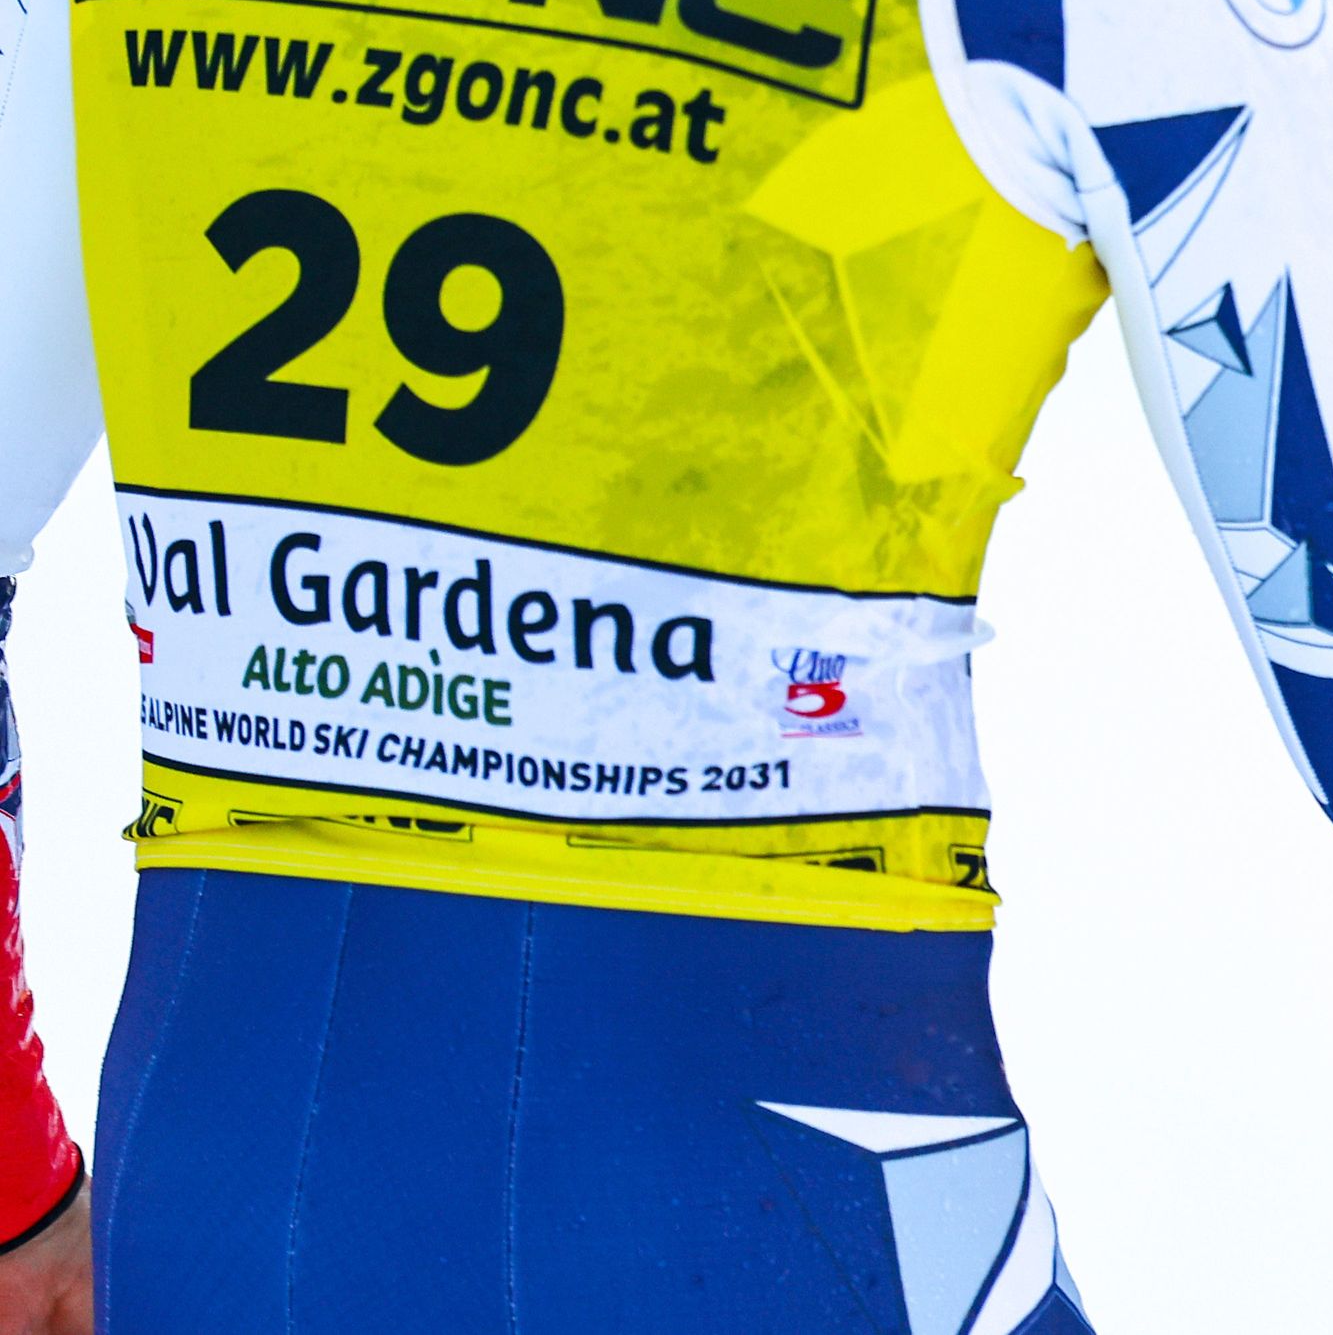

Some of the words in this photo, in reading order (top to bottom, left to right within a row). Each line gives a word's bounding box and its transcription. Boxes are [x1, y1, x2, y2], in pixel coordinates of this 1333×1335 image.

[124, 28, 727, 165] www.zgonc.at
[189, 188, 565, 467] 29
[128, 513, 233, 617] Val
[269, 531, 716, 683] Gardena
[149, 697, 209, 741] ALPINE
[213, 708, 306, 753] WORLD
[313, 722, 369, 759] SKI
[376, 731, 690, 796] CHAMPIONSHIPS
[702, 760, 792, 792] 2031
[784, 680, 847, 719] 5
